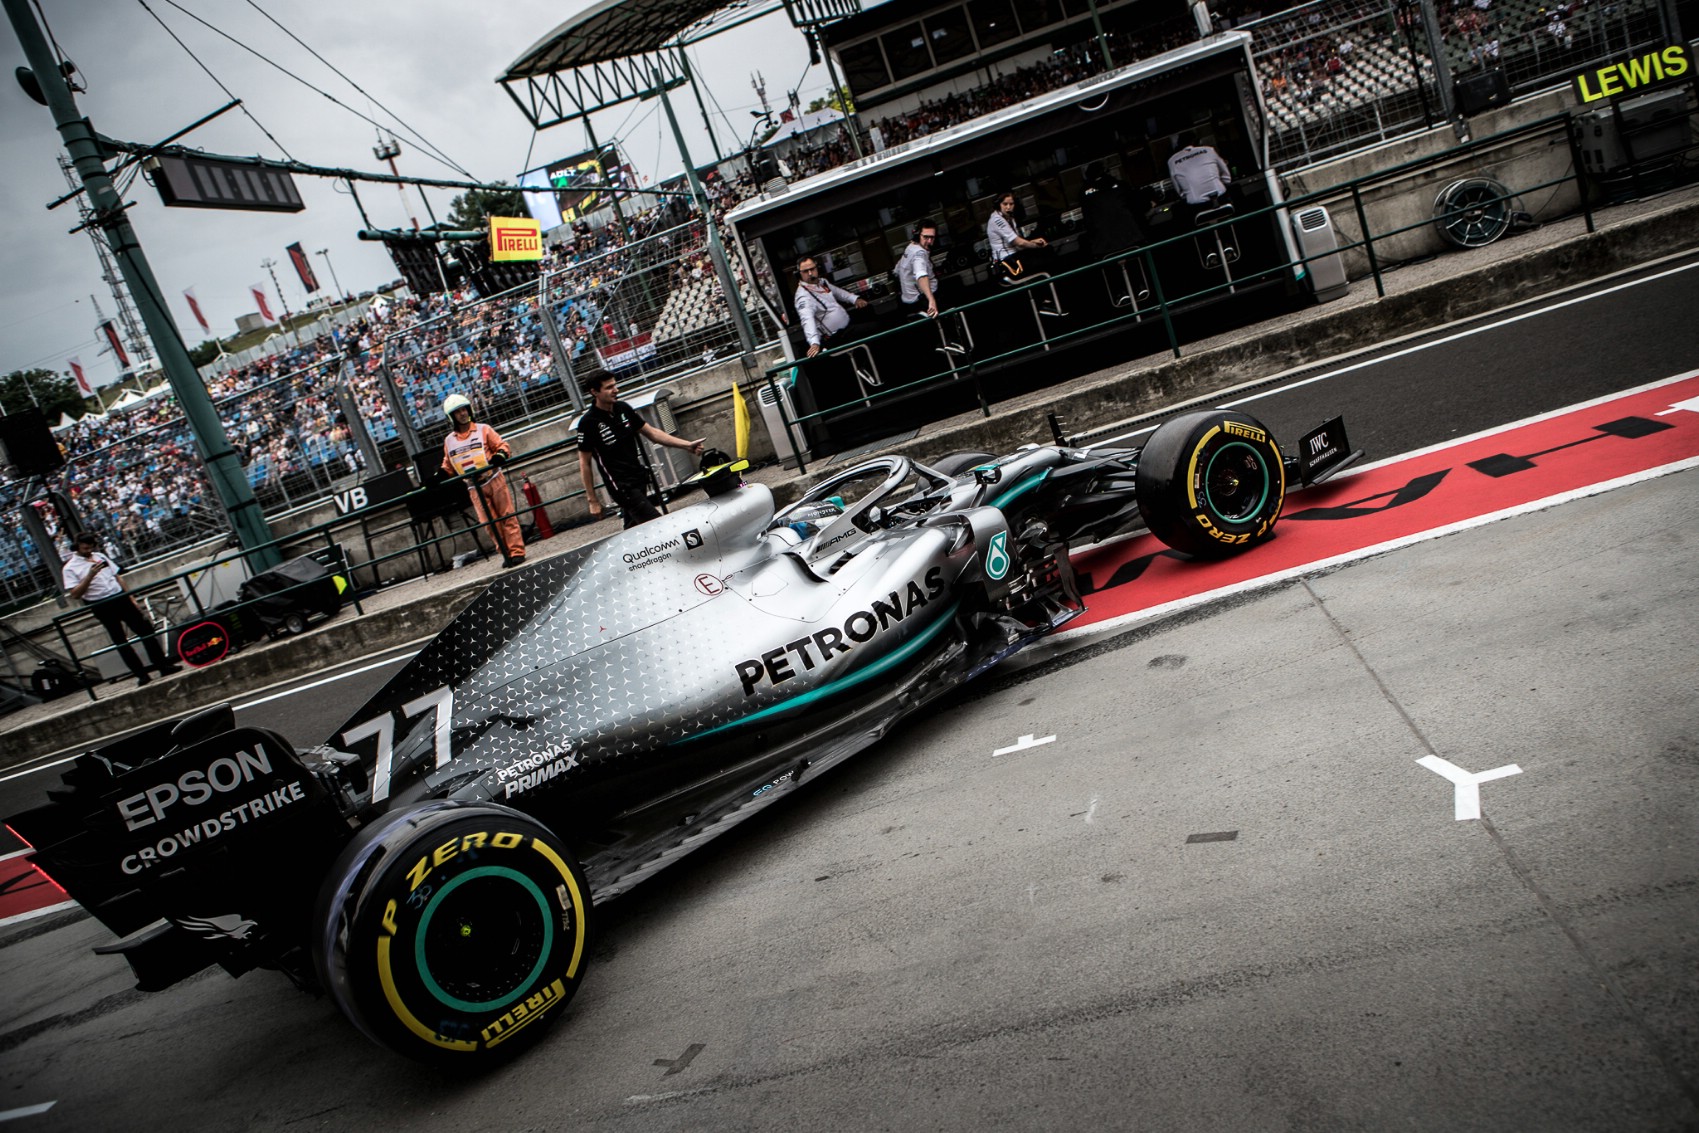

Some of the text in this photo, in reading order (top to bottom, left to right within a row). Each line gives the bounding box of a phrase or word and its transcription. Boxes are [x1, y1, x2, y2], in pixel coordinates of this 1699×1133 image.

[1577, 45, 1689, 103] LEWIS
[1174, 149, 1208, 165] PETRONAS
[497, 228, 538, 251] PIRELLI
[1223, 420, 1266, 444] PIRELLI
[1309, 431, 1329, 455] IWC
[333, 486, 370, 514] VB
[829, 528, 857, 547] AMG
[1195, 513, 1251, 545] ZERO
[622, 538, 680, 564] Qualcomm
[628, 552, 672, 572] snapdragon
[698, 576, 720, 594] E
[735, 566, 945, 697] PETRONAS
[341, 684, 453, 804] 77
[499, 740, 573, 781] PETRONAS
[505, 750, 581, 800] PRIMAX
[116, 743, 273, 832] EPSON
[120, 780, 306, 875] CROWDSTRIKE
[381, 898, 398, 936] P
[405, 831, 524, 893] ZERO
[480, 978, 567, 1049] PIRELLI
